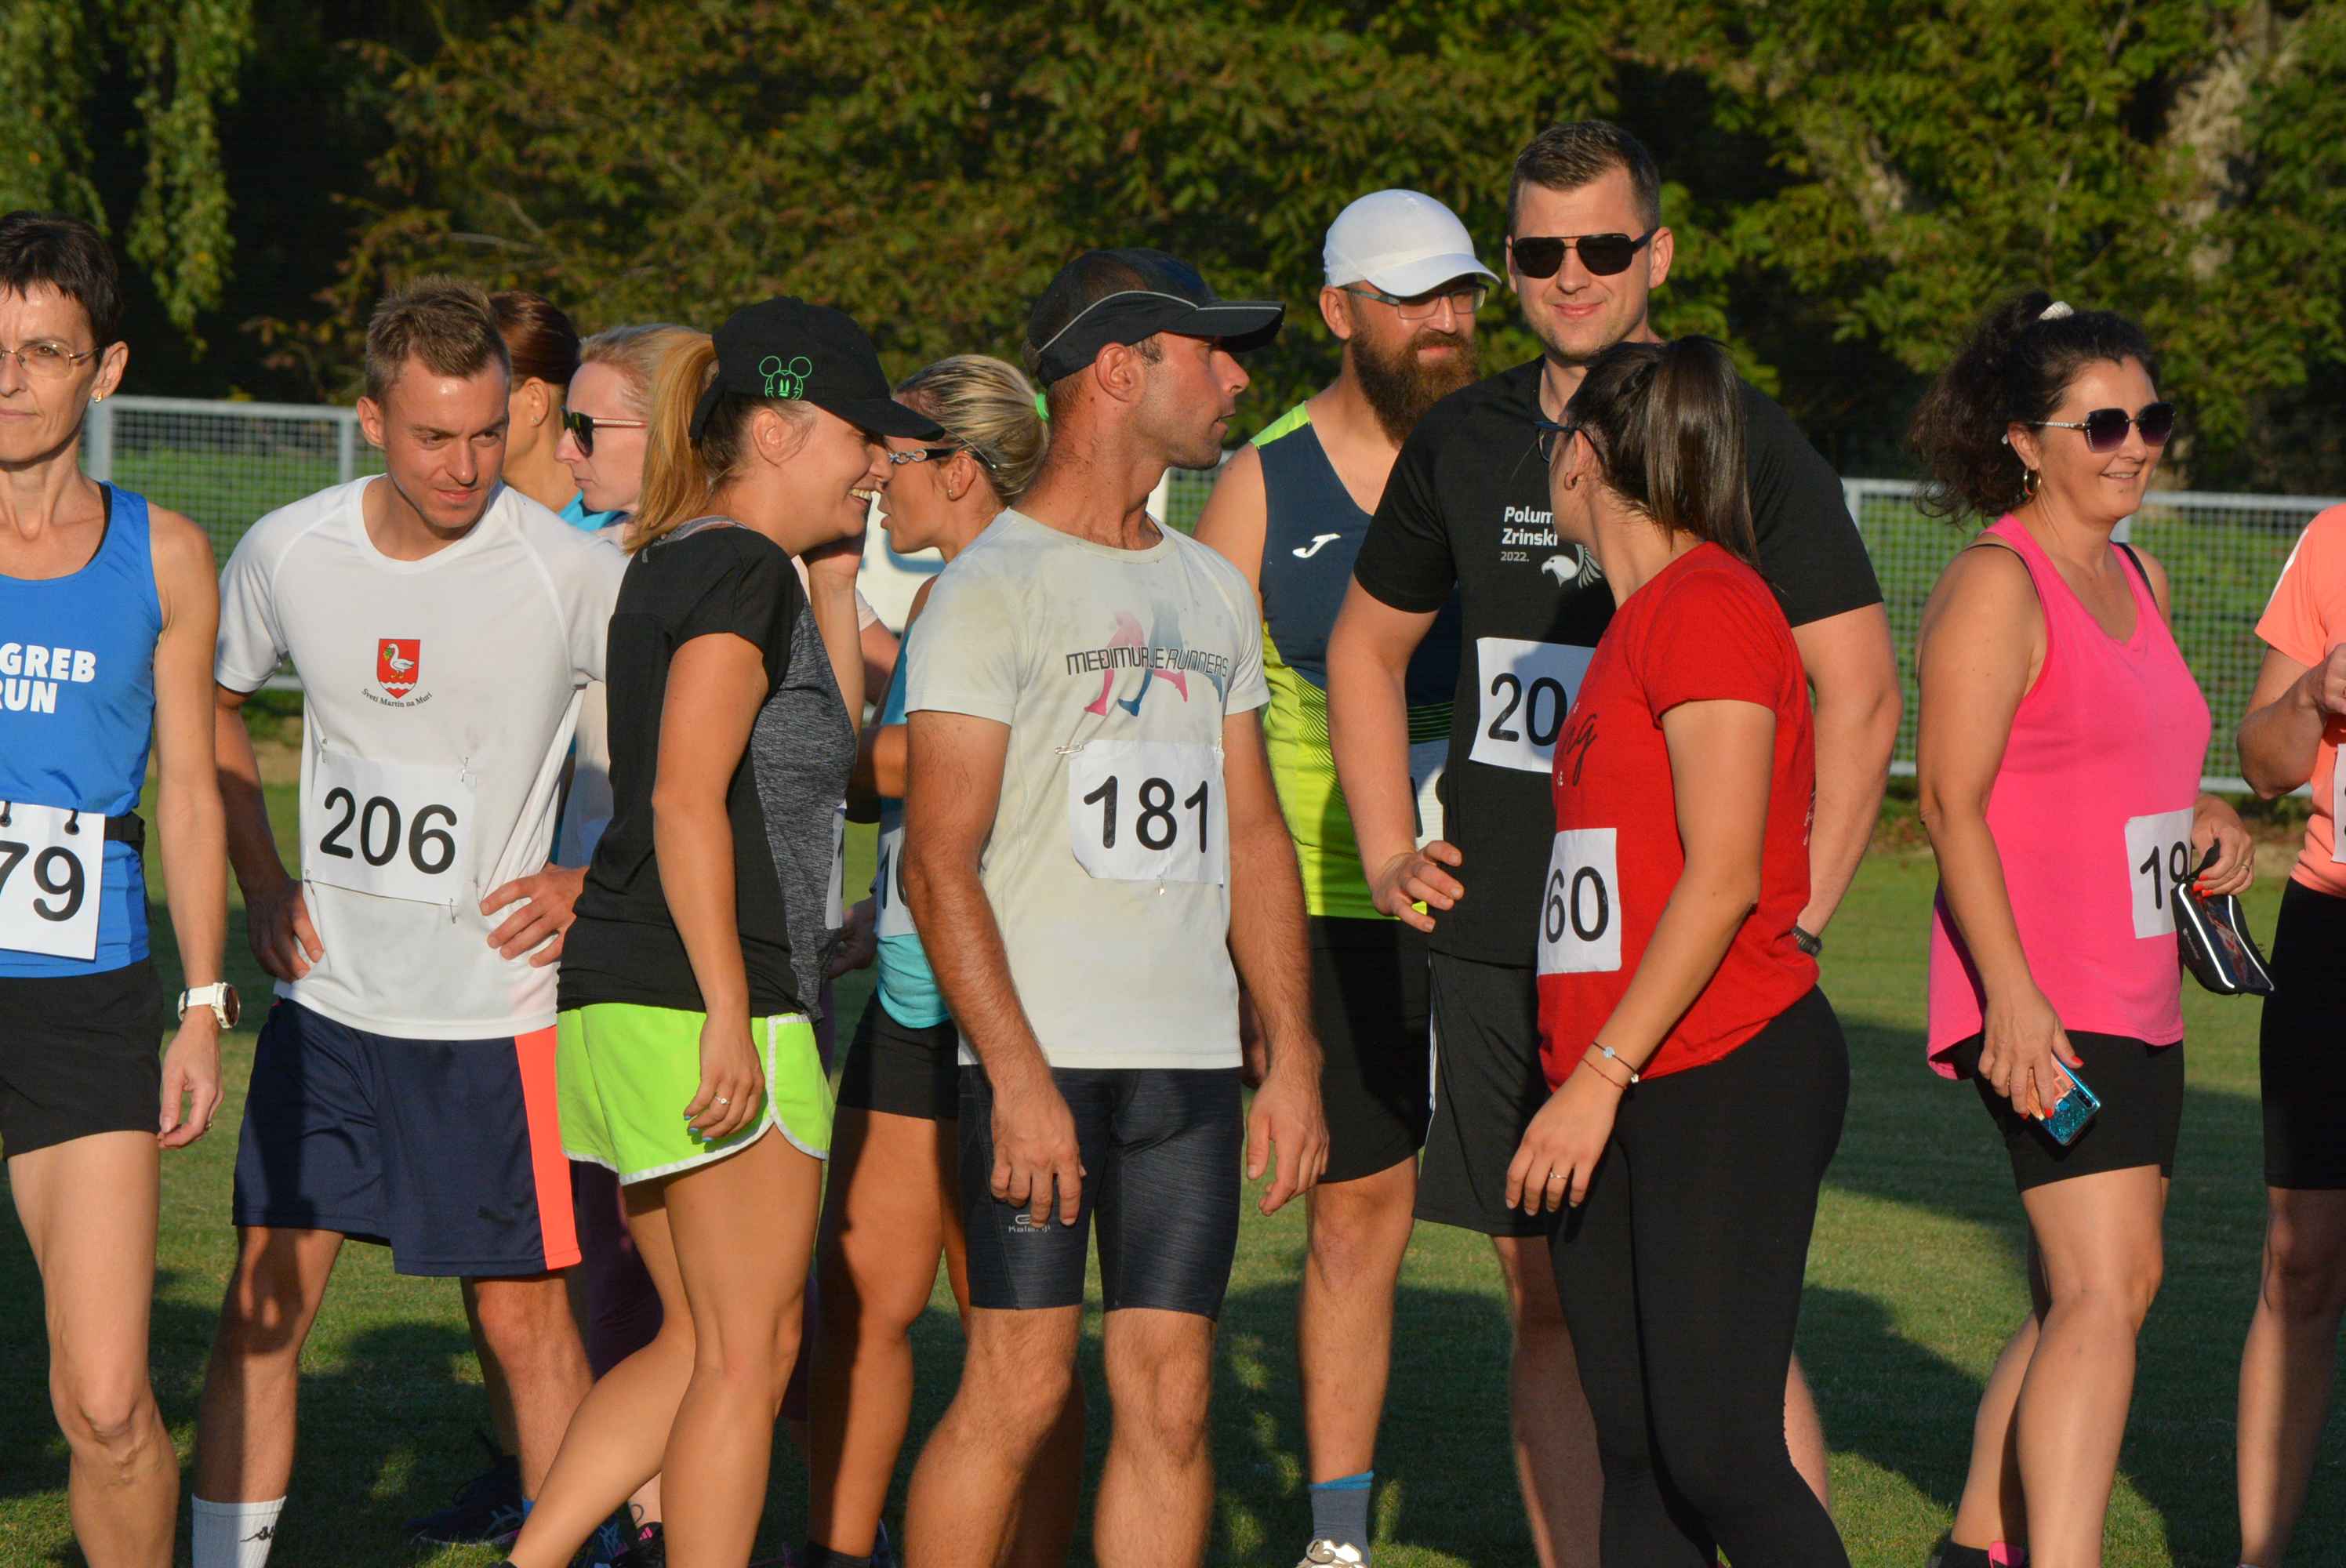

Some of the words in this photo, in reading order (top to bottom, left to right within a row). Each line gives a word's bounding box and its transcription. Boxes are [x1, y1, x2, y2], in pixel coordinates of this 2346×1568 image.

[1502, 528, 1558, 546] Zrinski
[1500, 550, 1530, 562] 2022.
[1165, 647, 1229, 677] RUNNERS
[361, 688, 379, 702] Sveti
[380, 698, 405, 707] Martin
[415, 691, 433, 705] Muri
[1084, 775, 1208, 854] 181
[320, 786, 457, 875] 206
